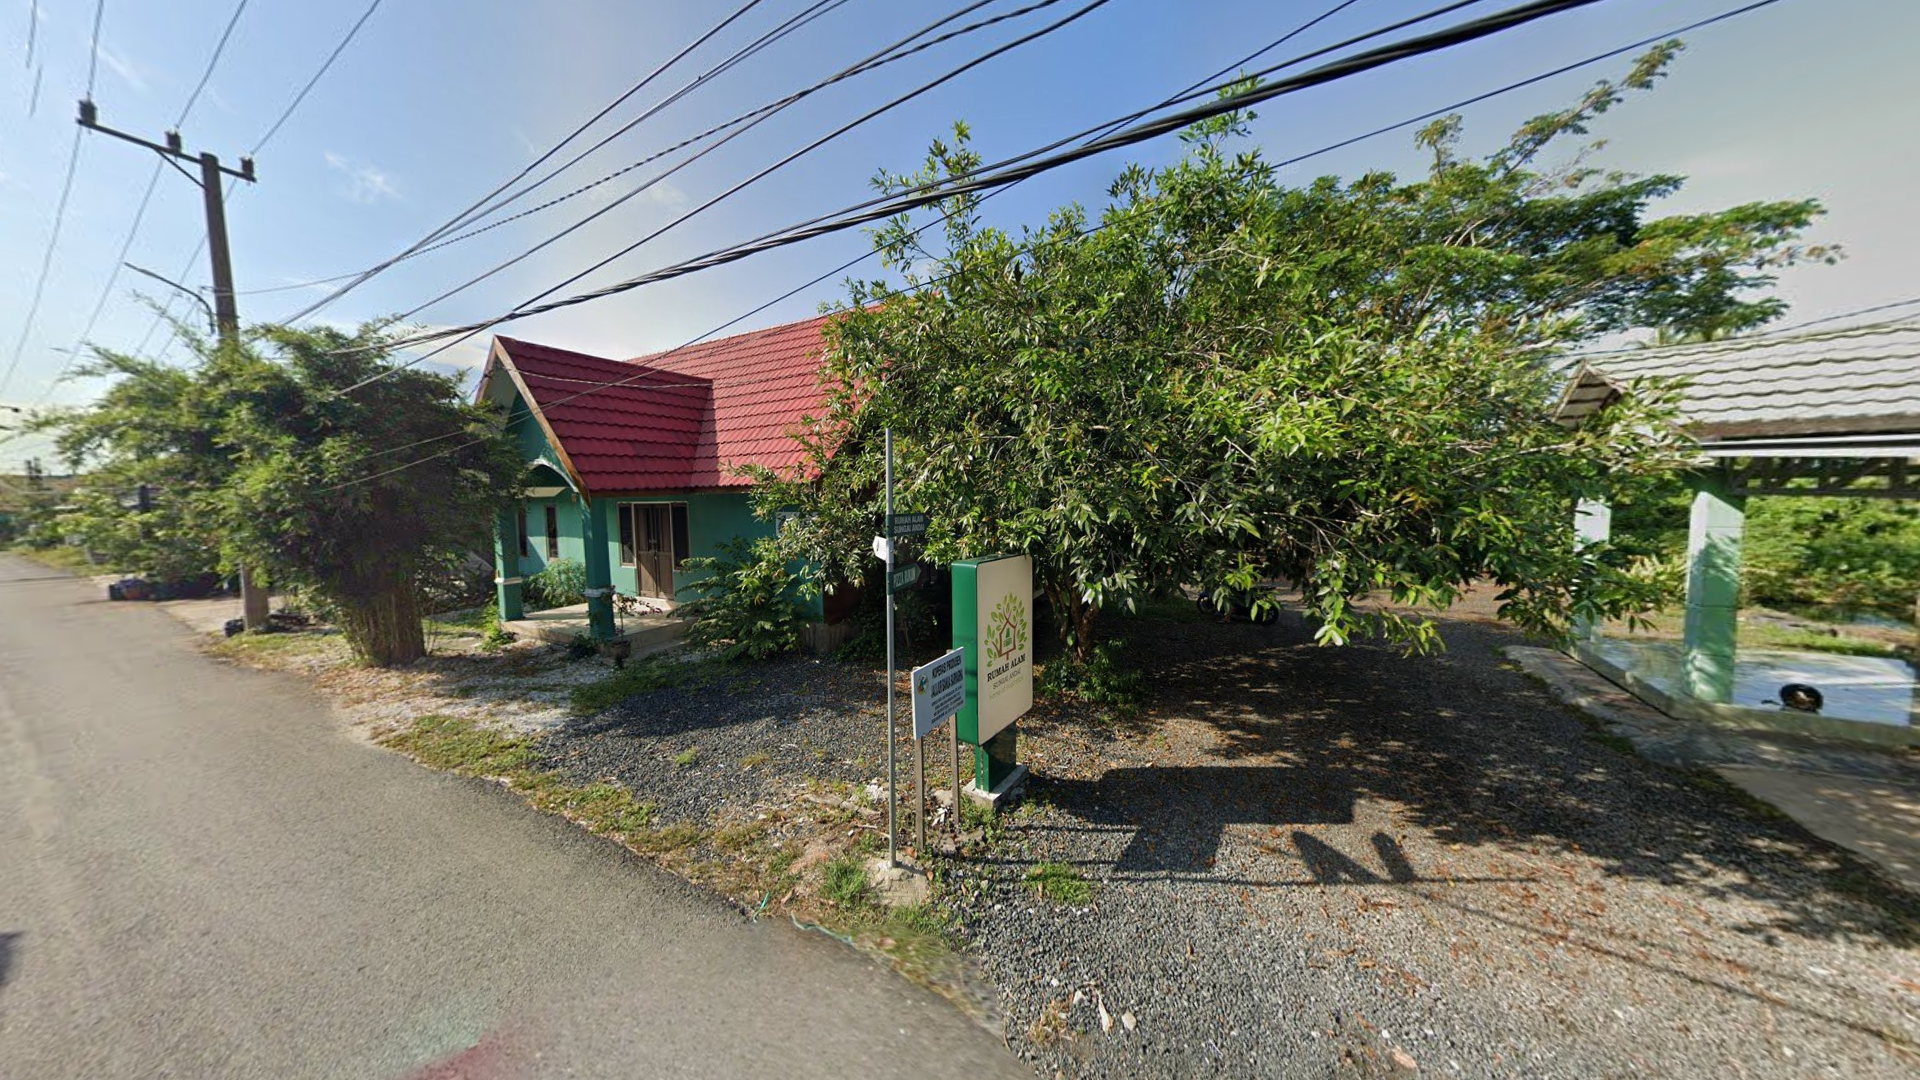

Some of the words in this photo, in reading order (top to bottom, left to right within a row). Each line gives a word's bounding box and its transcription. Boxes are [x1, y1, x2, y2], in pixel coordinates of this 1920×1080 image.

[987, 662, 1010, 682] RUMAH
[1010, 653, 1026, 669] ALAM
[993, 675, 1009, 690] SUNGAI
